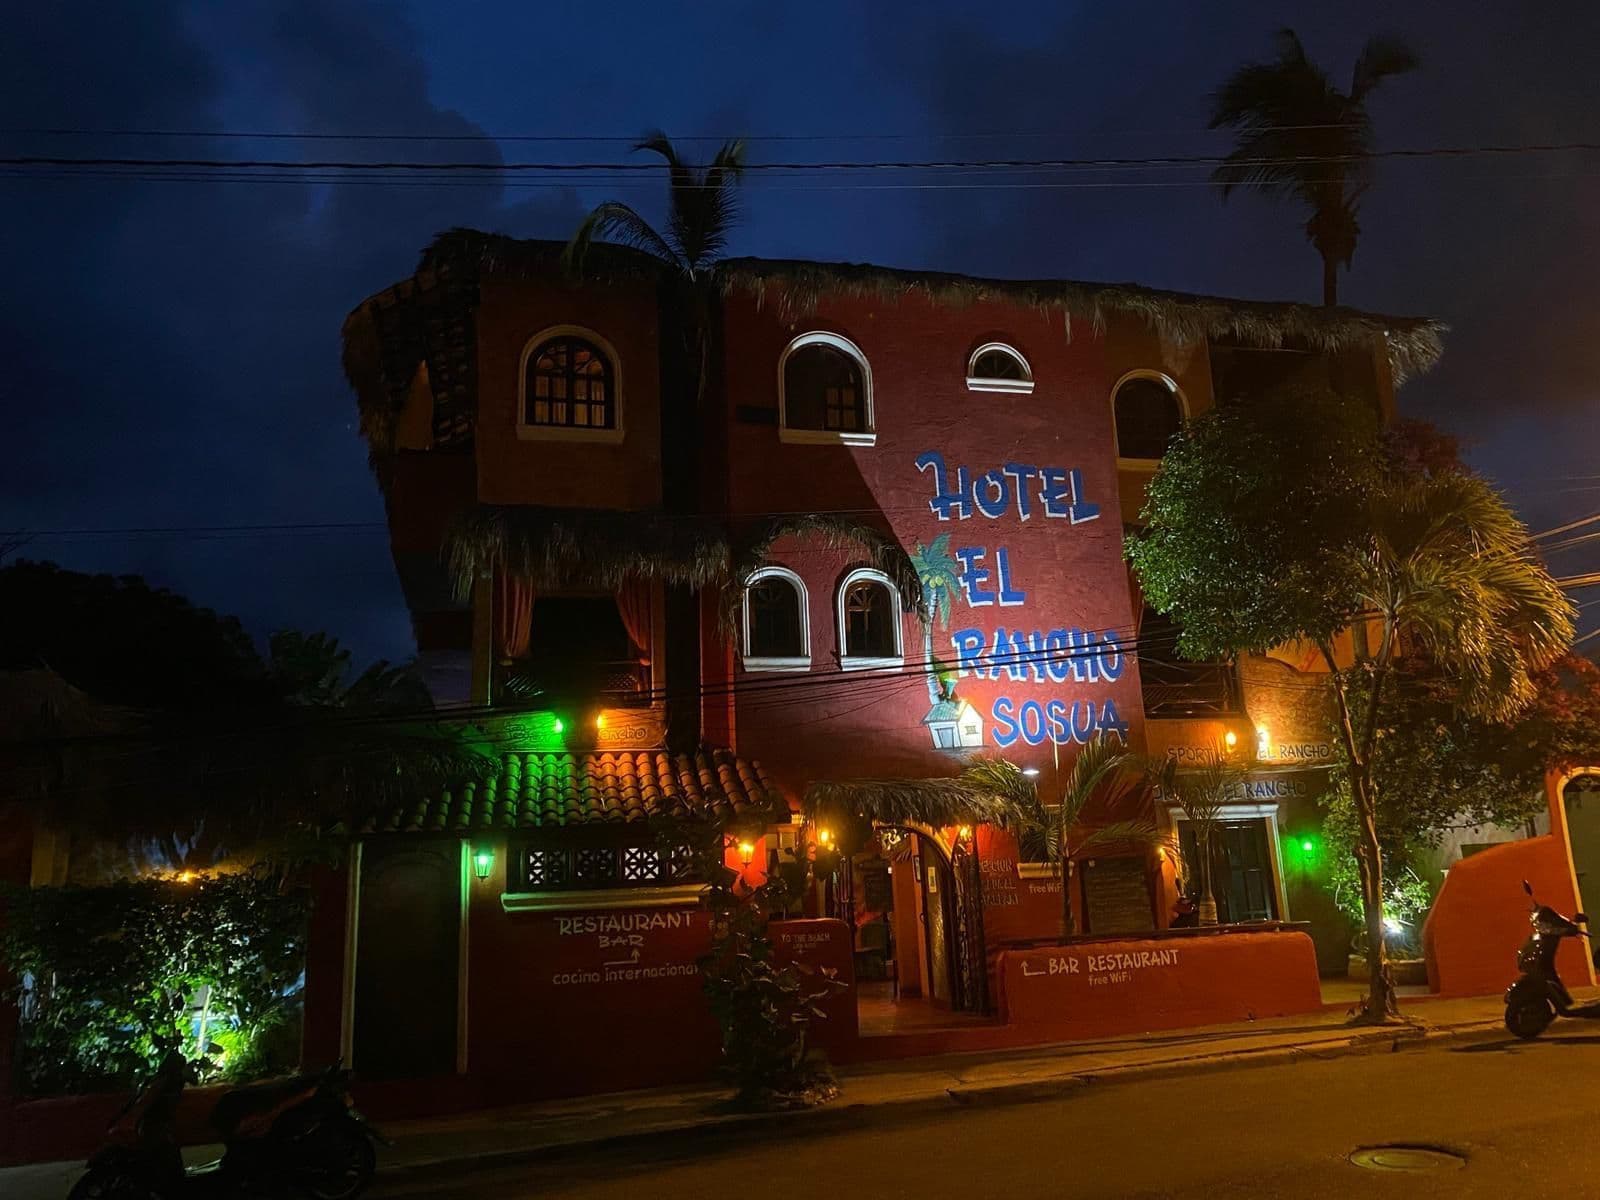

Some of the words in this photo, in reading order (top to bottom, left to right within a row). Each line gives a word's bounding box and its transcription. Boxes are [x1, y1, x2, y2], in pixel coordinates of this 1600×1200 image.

[914, 450, 1101, 525] HOTEL
[955, 547, 1026, 607] EL
[951, 627, 1124, 683] RANCHO
[991, 697, 1129, 748] SOSUA
[1258, 746, 1276, 759] EL
[1279, 743, 1330, 759] RANCHO
[1223, 782, 1242, 799] EL
[1243, 780, 1307, 798] RANCHO
[553, 910, 697, 936] RESTAURANT
[598, 933, 645, 949] BAR
[1049, 956, 1080, 975] BAR
[1087, 949, 1179, 973] RESTAURANT
[1088, 974, 1108, 987] free
